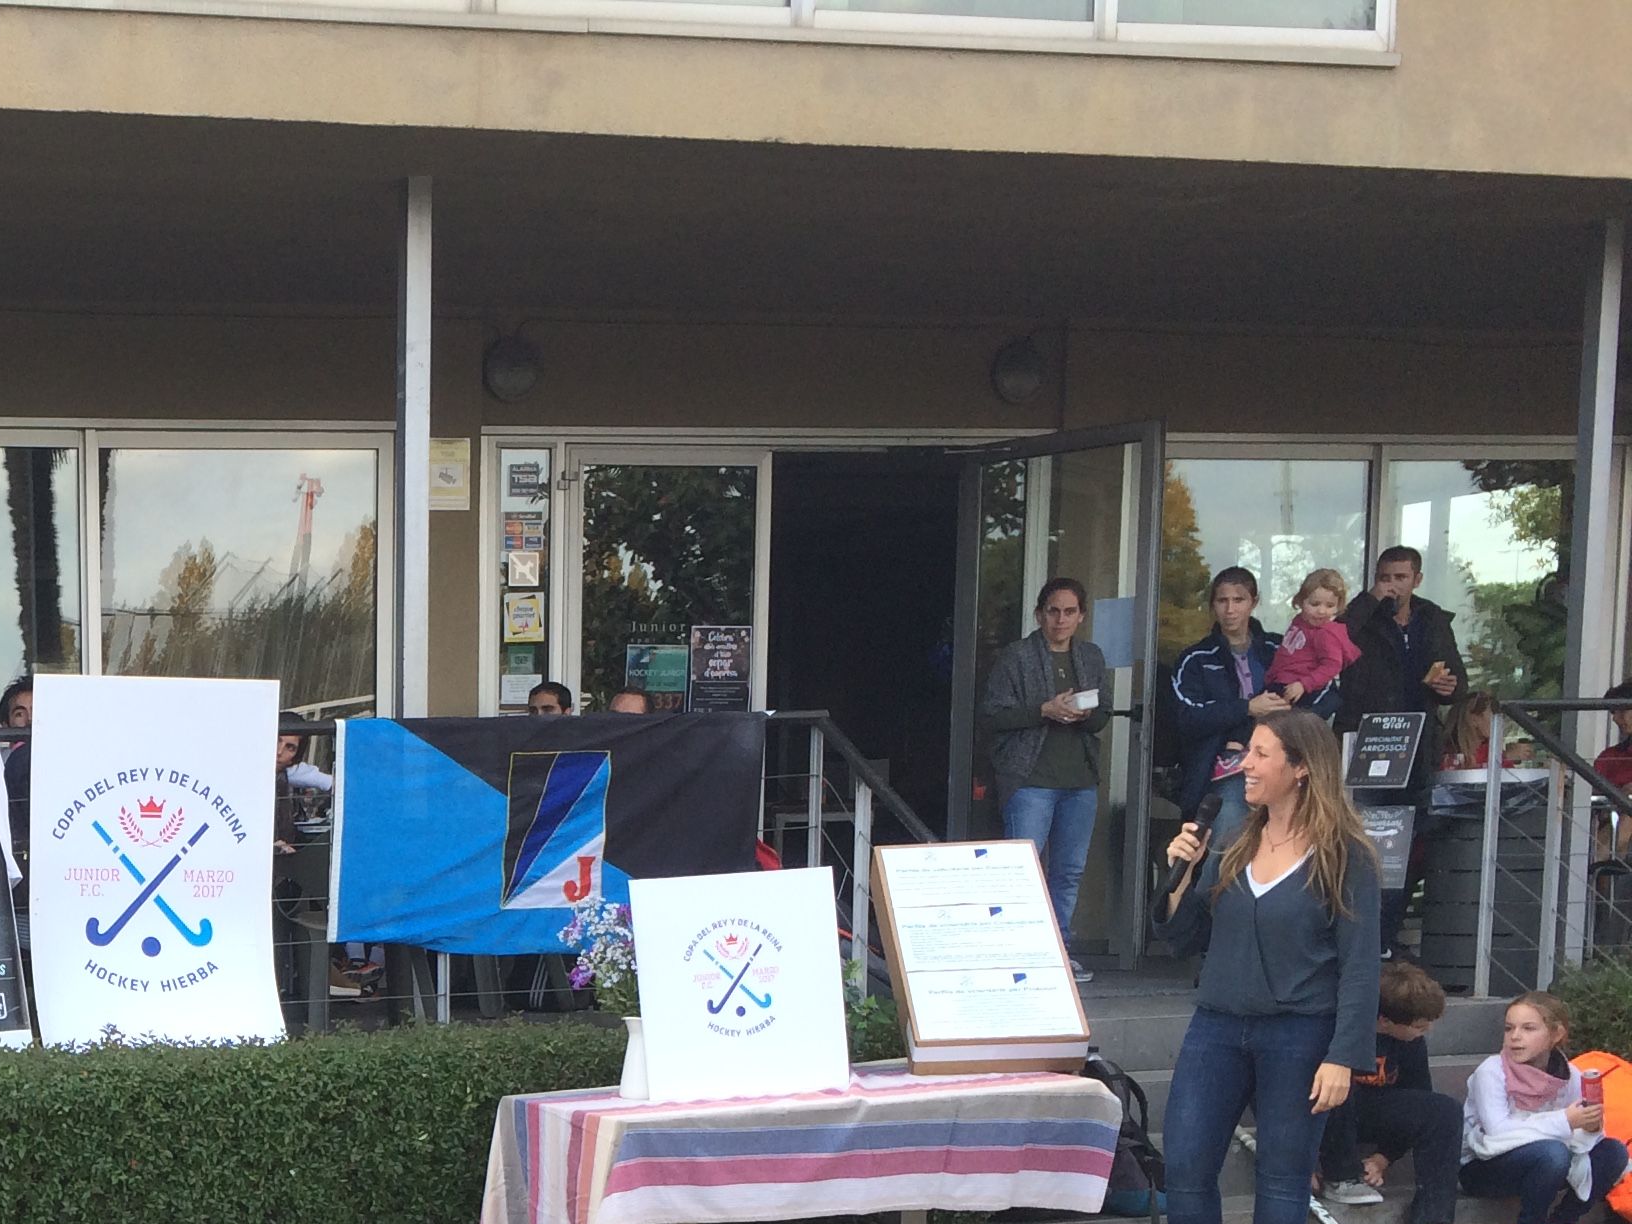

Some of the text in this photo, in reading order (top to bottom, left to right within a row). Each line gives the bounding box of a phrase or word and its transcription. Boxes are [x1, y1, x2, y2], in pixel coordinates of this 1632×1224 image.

[631, 621, 686, 633] Junior
[1372, 716, 1405, 724] menu
[1382, 721, 1411, 729] diari
[1361, 744, 1407, 752] ARROSSOS
[52, 767, 247, 845] COPA DEL REY Y DE LA REINA
[64, 867, 121, 882] JUNIOR
[183, 869, 234, 883] MARZO
[563, 856, 596, 903] J
[80, 884, 105, 897] F.C.
[193, 885, 224, 898] 2017
[683, 939, 699, 962] COPA
[697, 927, 712, 941] DEL
[712, 919, 728, 930] REY
[737, 919, 749, 927] DE
[750, 922, 760, 932] LA
[762, 929, 783, 952] REINA
[84, 959, 219, 992] HOCKEY HIERBA
[707, 1015, 776, 1037] HOCKEY HIERBA
